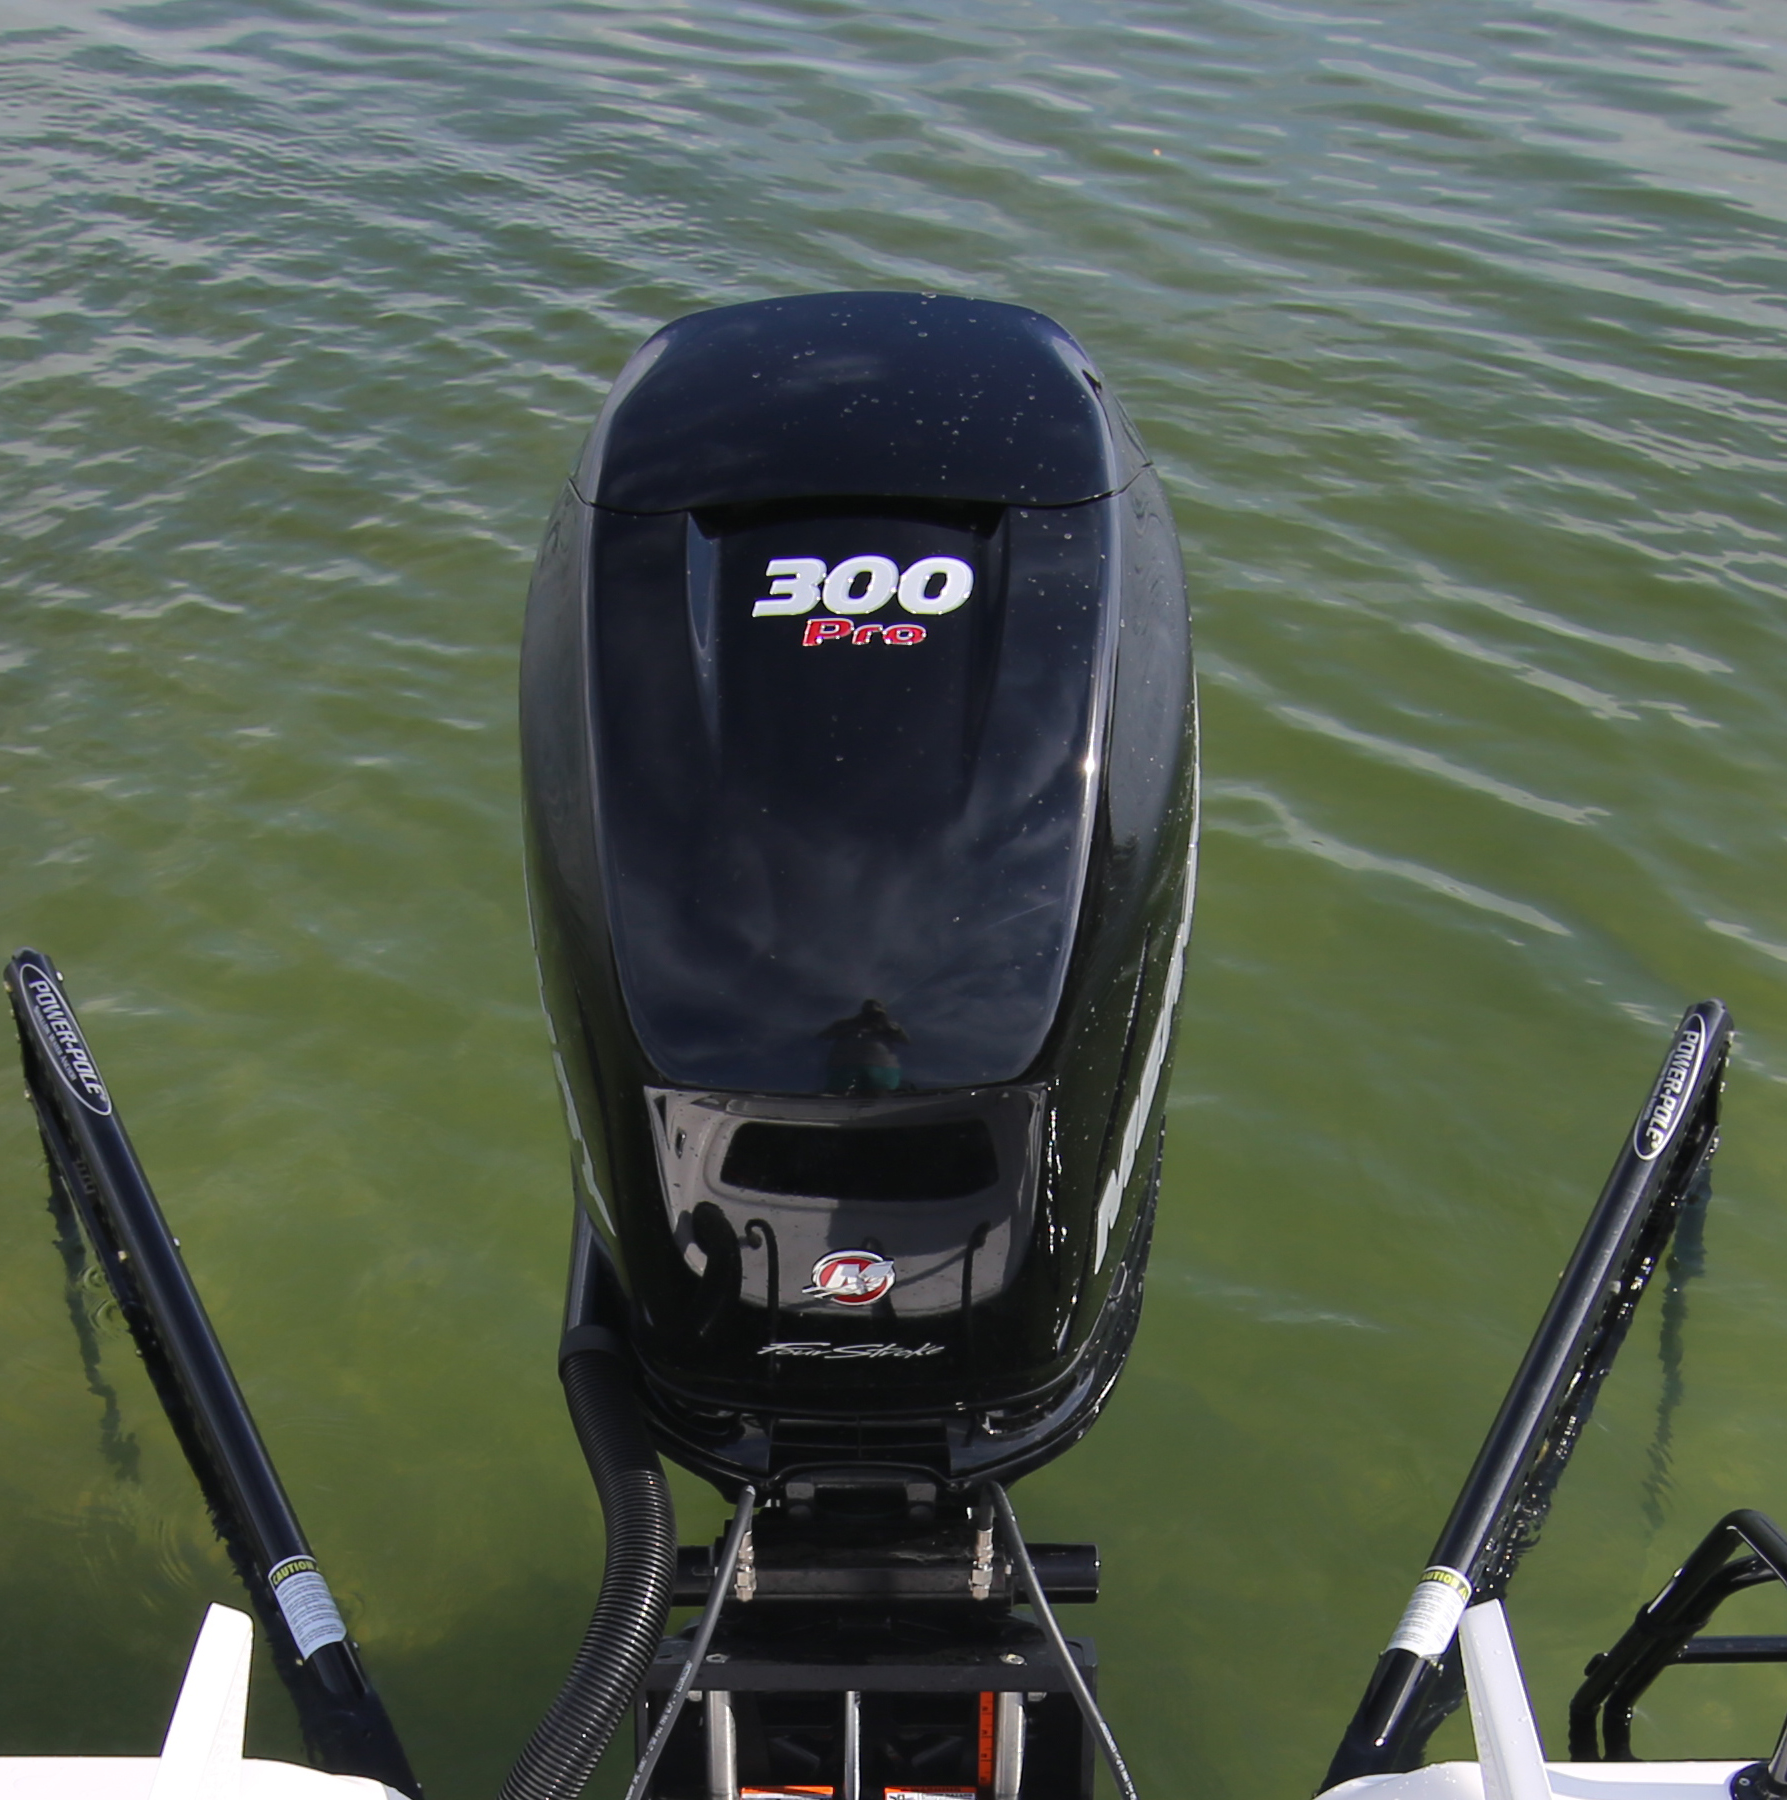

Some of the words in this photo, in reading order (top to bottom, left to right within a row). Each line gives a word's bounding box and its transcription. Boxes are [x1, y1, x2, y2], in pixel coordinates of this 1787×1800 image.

[751, 554, 975, 618] 300
[801, 617, 928, 647] Pro
[272, 1560, 315, 1586] CAUTION
